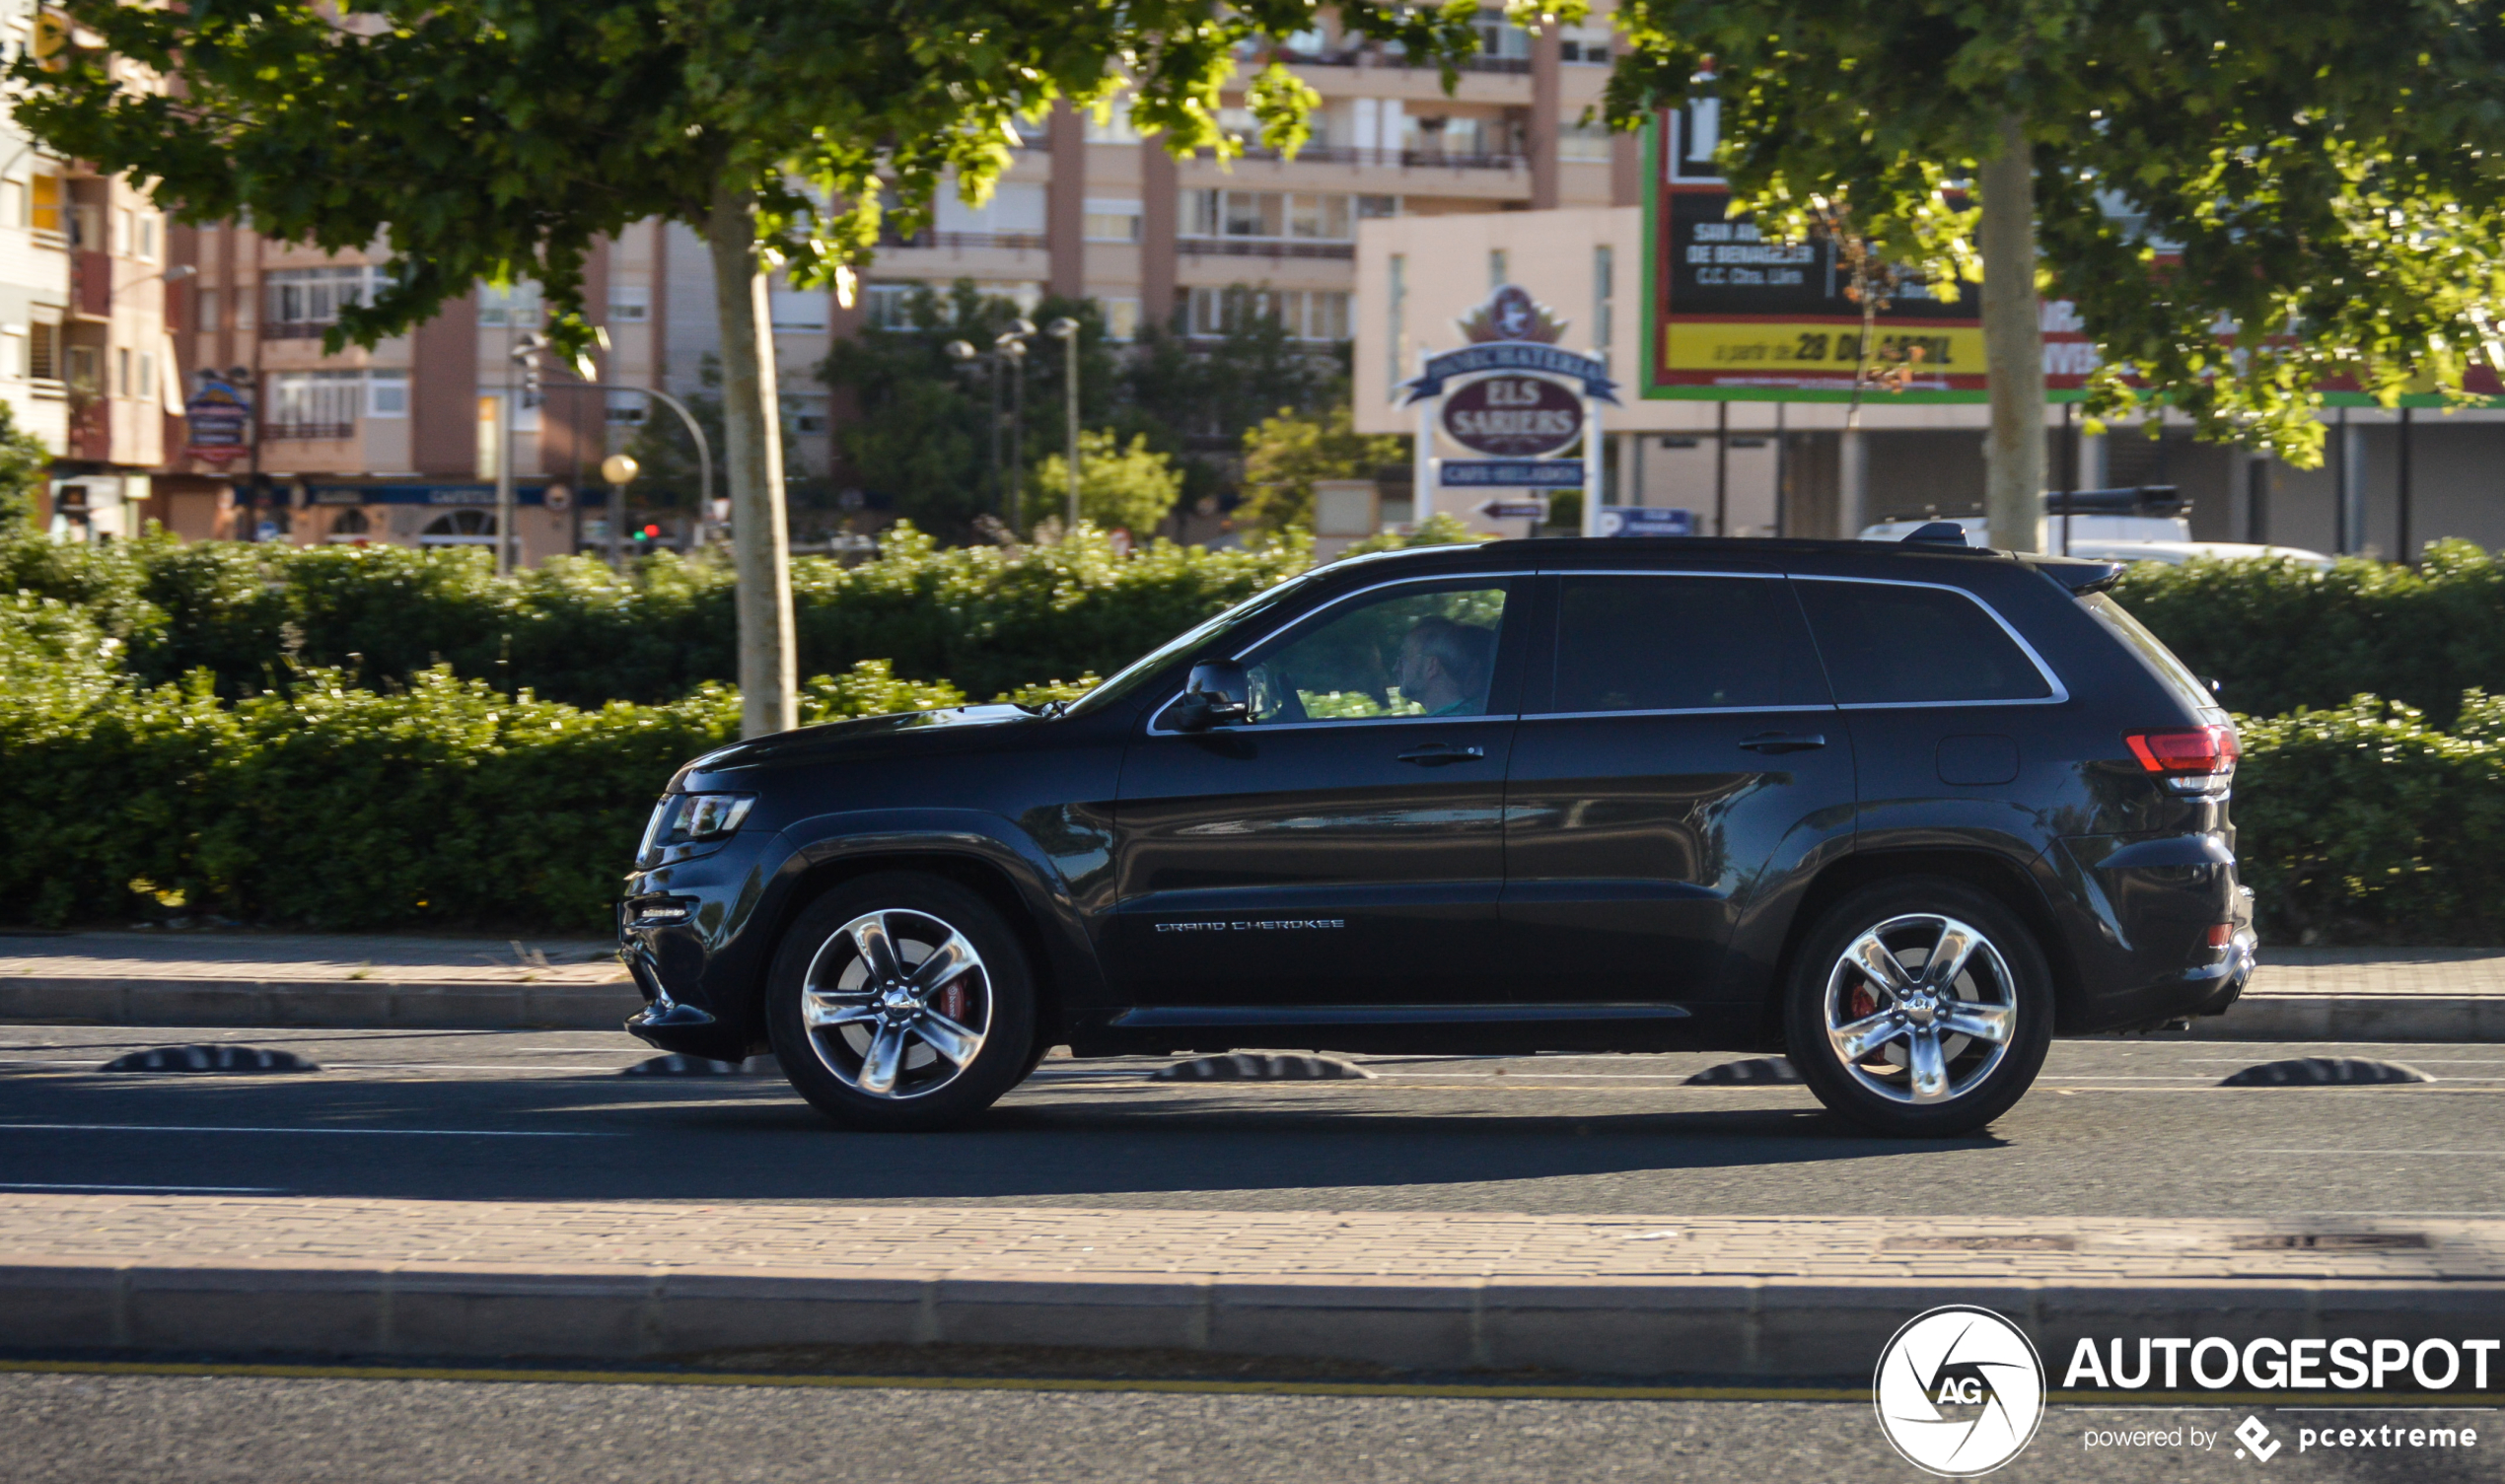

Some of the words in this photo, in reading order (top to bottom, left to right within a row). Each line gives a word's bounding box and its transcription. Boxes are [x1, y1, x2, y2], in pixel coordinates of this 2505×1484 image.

[1485, 380, 1542, 406] ELS
[1452, 409, 1576, 435] SARIERS
[1154, 922, 1226, 932] GRAND
[1231, 919, 1345, 930] CHEROKEE
